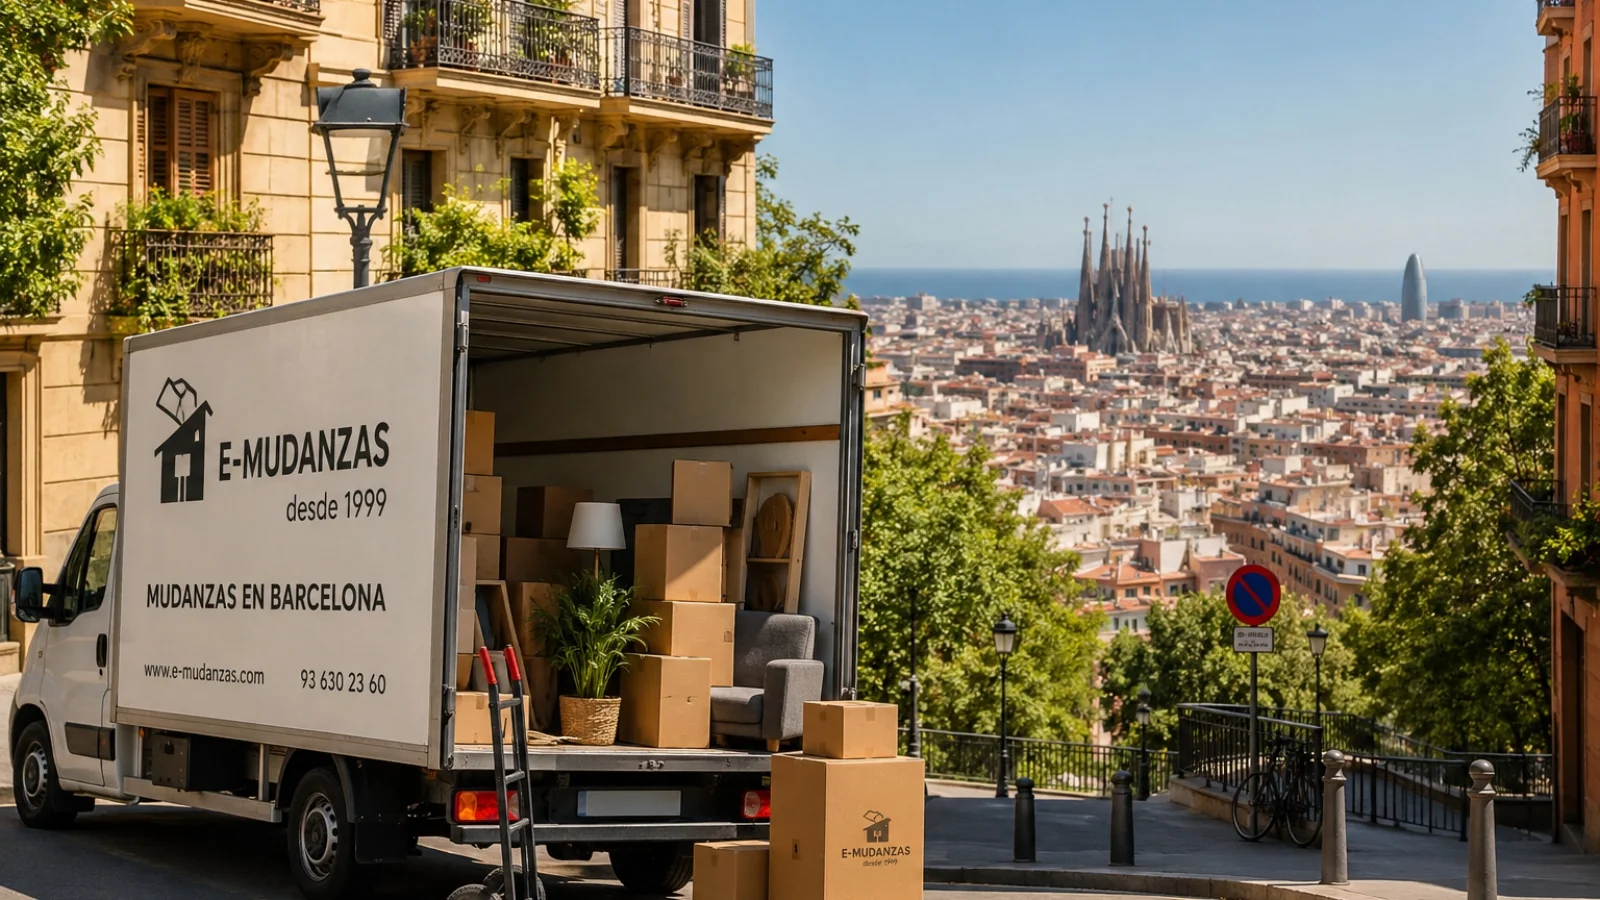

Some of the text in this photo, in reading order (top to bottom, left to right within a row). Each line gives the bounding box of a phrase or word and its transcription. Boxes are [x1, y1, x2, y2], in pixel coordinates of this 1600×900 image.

[218, 421, 391, 481] E-MUDANZAS
[286, 488, 388, 522] desde 1999
[147, 583, 387, 612] MUDANZAS EN BARCELONA
[144, 662, 265, 685] www.e-mudanzas.com
[300, 669, 387, 695] 93 630 23 60
[841, 845, 911, 859] E-MUDANZAS
